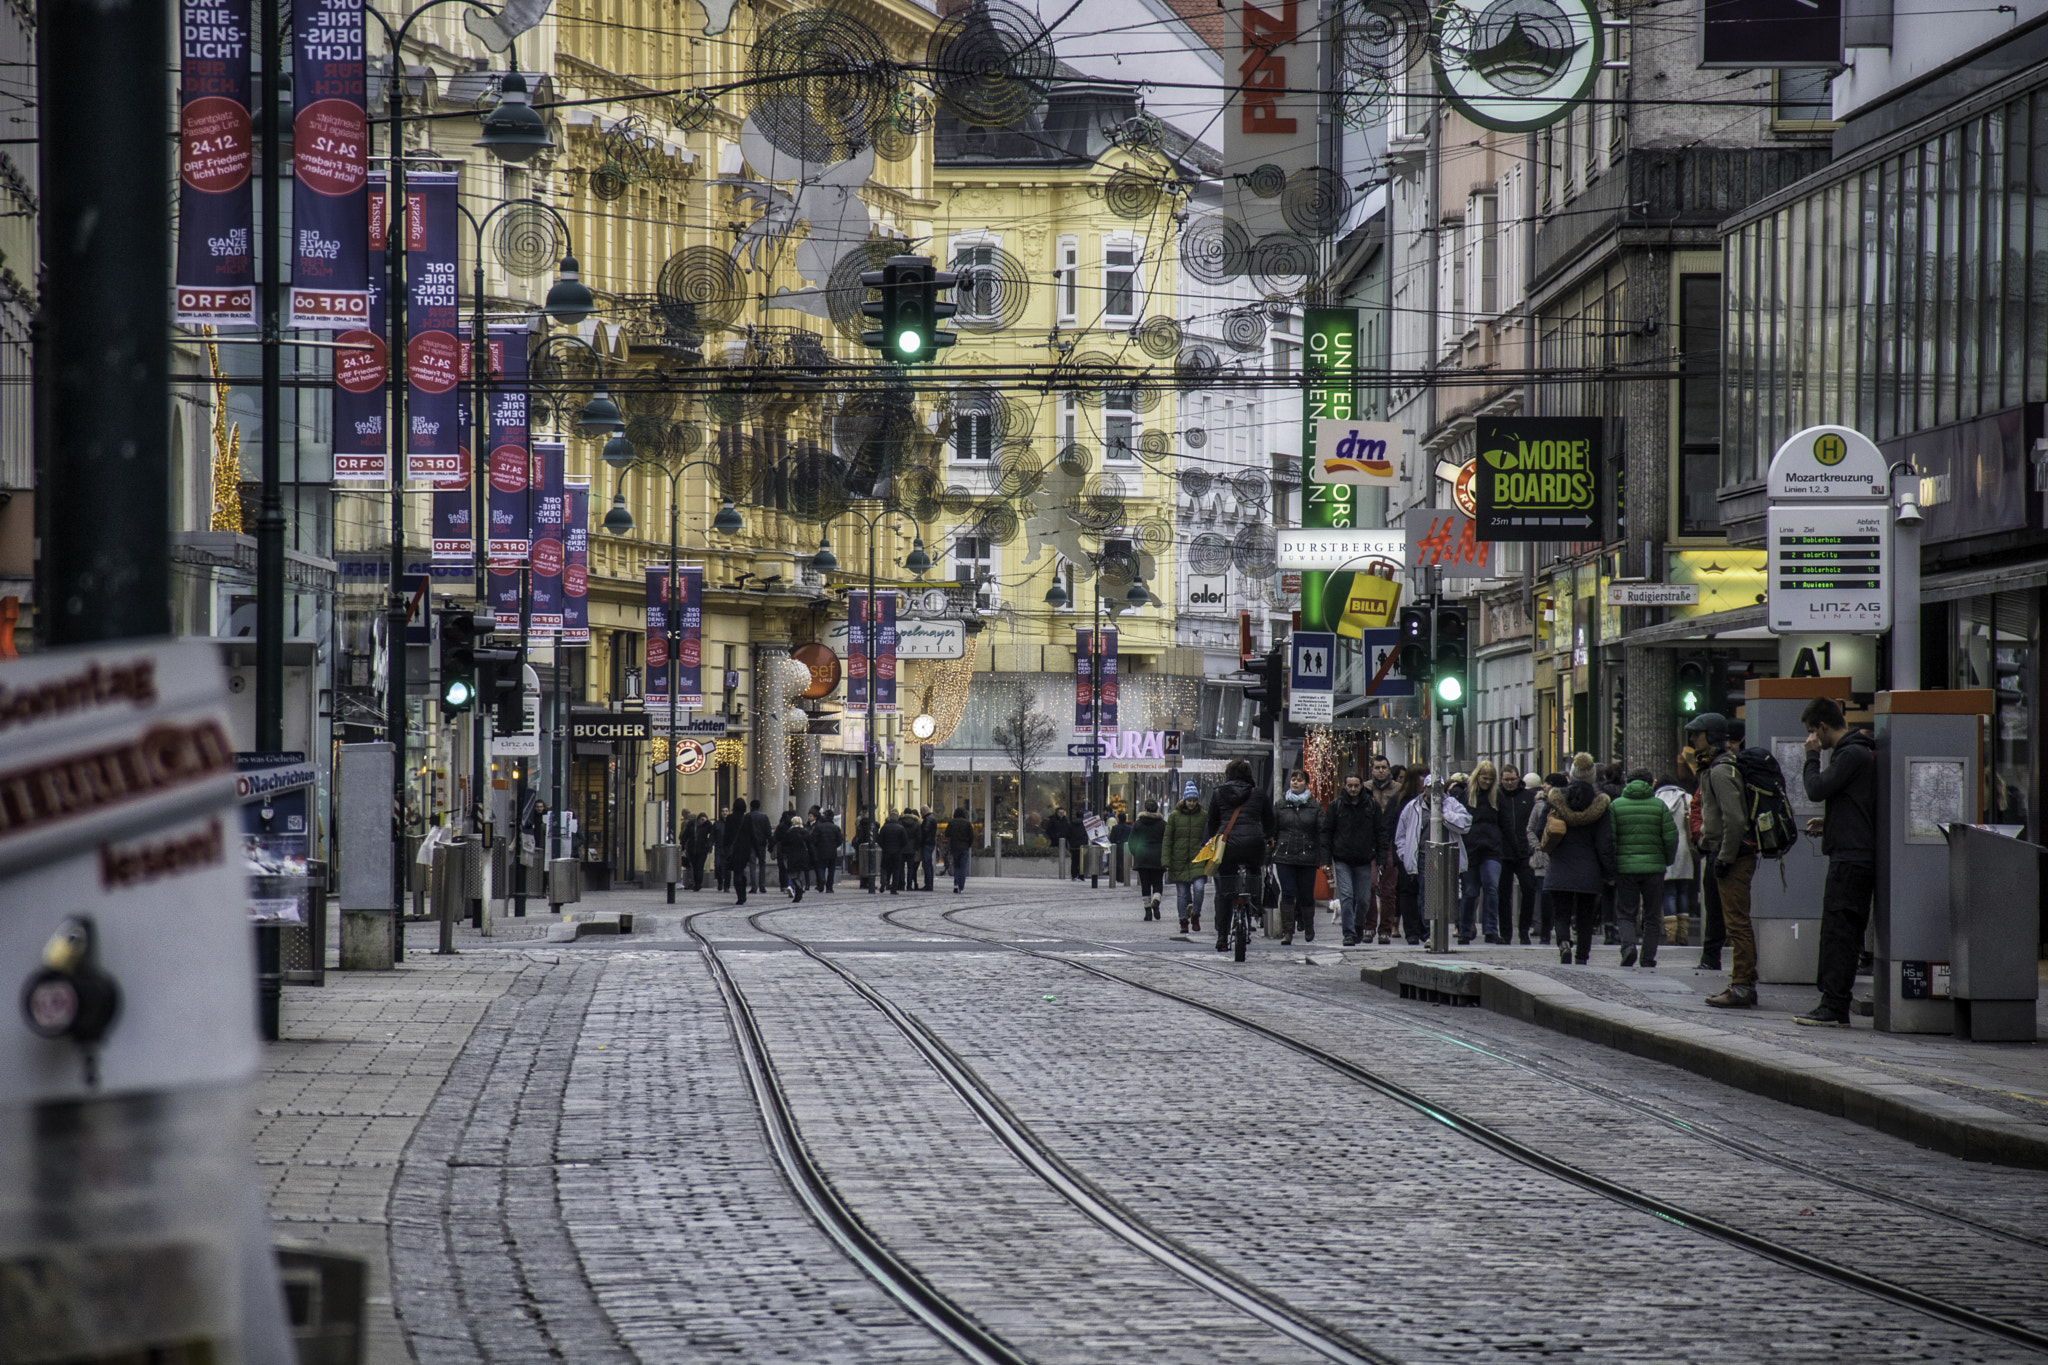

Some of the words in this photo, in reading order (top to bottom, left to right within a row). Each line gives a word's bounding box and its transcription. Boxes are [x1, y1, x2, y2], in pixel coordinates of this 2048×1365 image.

[185, 9, 239, 24] FRIE-
[185, 26, 247, 41] DENS-
[186, 43, 242, 58] LICHT
[186, 60, 226, 75] FÜR
[186, 77, 239, 92] DICH.
[191, 135, 238, 155] 24.12.
[184, 160, 204, 172] ORF
[369, 196, 384, 239] Passage
[230, 228, 247, 238] DIE
[208, 238, 247, 247] GANZE
[211, 246, 247, 256] STADT
[182, 294, 227, 307] ORF
[1336, 430, 1387, 460] dm
[1823, 440, 1838, 460] H
[1519, 440, 1584, 470] MORE
[338, 459, 368, 468] ORF
[1786, 473, 1874, 484] Mozartkreuzung
[1495, 473, 1587, 503] BOARDS
[1491, 517, 1509, 526] 25m
[1283, 543, 1405, 553] DURSTBERGER
[1417, 516, 1490, 568] H&M
[1628, 591, 1691, 603] Rudigierstraße
[1352, 600, 1385, 613] BILLA
[1810, 602, 1851, 612] LINZ
[1855, 602, 1880, 612] AG
[1791, 641, 1831, 678] A1
[574, 725, 645, 737] BÜCHER
[1791, 923, 1799, 940] 1
[1904, 968, 1916, 977] HS
